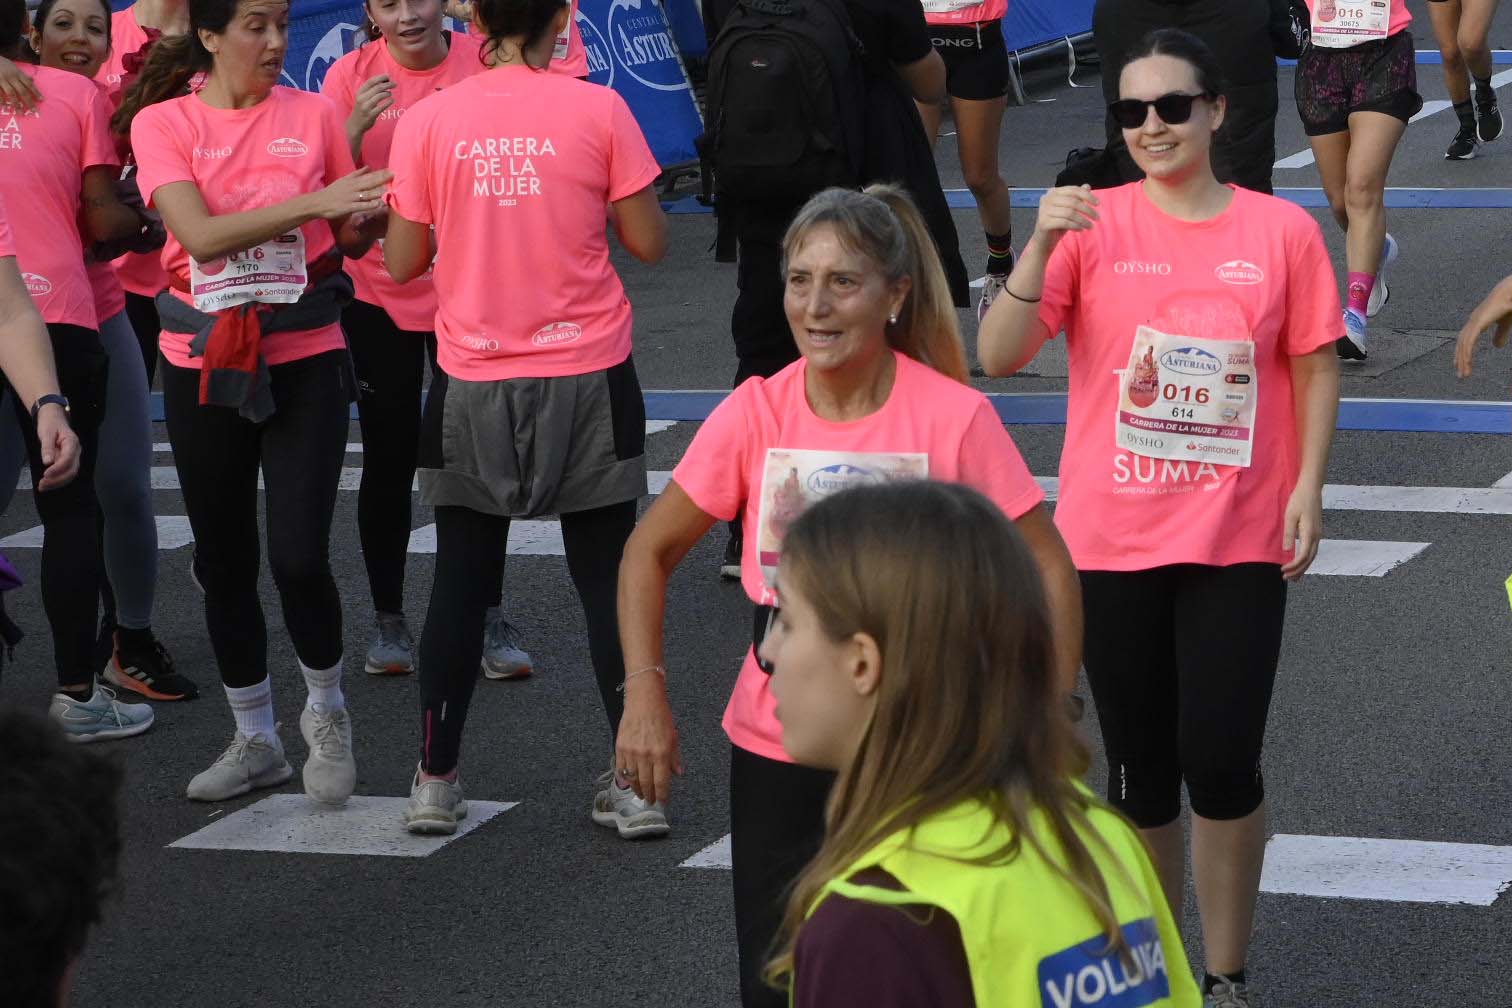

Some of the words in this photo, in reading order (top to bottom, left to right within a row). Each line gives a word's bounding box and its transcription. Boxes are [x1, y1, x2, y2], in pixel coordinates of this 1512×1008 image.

[1338, 8, 1363, 18] 016
[455, 138, 557, 160] CARRERA
[474, 158, 501, 177] DE
[509, 157, 537, 176] LA
[473, 177, 541, 197] MUJER
[236, 263, 259, 274] 7170
[1113, 261, 1171, 276] OYSHO
[535, 329, 579, 345] ASTURIANA
[1165, 354, 1218, 372] ASTURIANA
[1227, 358, 1249, 366] SUMA
[1162, 383, 1210, 404] 016
[1171, 407, 1194, 419] 614
[1129, 417, 1165, 430] CARRERA
[1166, 423, 1177, 431] DE
[1191, 426, 1217, 435] MUJER
[1127, 433, 1164, 449] OYSHO
[1198, 443, 1240, 456] Santander
[1112, 453, 1220, 483] SUMA
